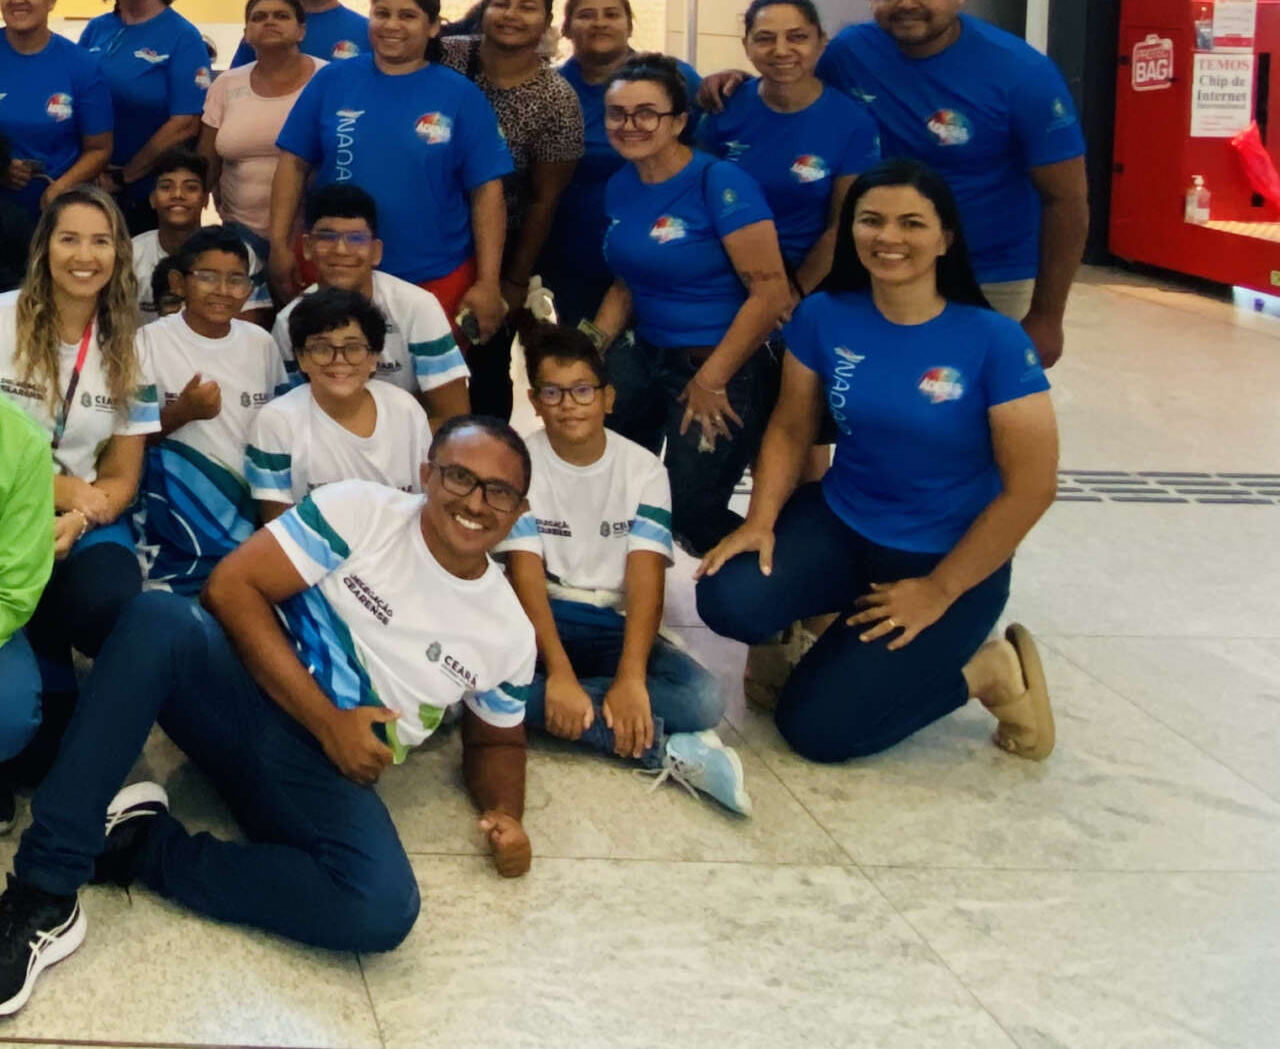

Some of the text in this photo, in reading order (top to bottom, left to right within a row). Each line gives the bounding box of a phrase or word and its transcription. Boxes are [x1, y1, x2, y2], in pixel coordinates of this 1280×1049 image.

[1135, 59, 1170, 83] BAG
[1200, 59, 1250, 71] TEMOS
[1199, 75, 1246, 89] Chip de
[1197, 90, 1247, 102] Internet
[343, 576, 390, 626] CEARENSE
[349, 574, 393, 617] DELEGAÇÃO
[444, 655, 479, 688] CEARÁ
